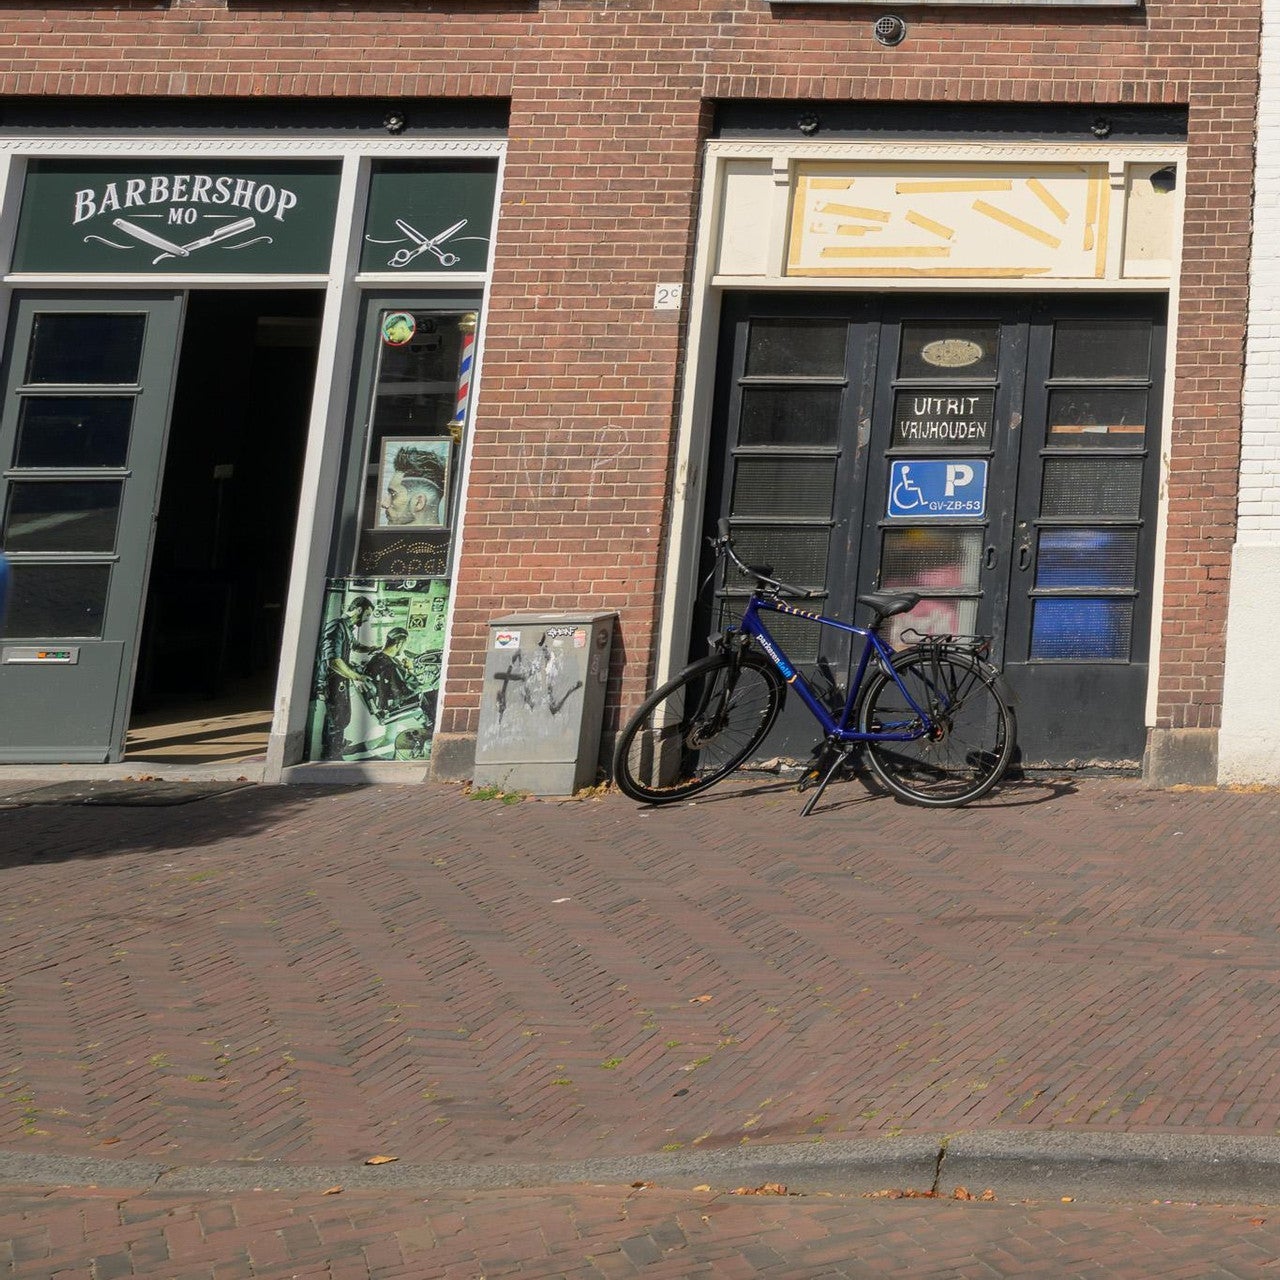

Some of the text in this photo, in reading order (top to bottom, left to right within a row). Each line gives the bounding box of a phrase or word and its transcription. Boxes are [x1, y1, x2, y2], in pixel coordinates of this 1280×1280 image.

[72, 175, 298, 225] BARBERSHOP
[168, 207, 198, 225] MO
[914, 397, 980, 416] UITRIT
[901, 421, 987, 439] VRIJHOUDEN
[945, 464, 974, 497] P
[929, 500, 981, 511] GV-ZB-53
